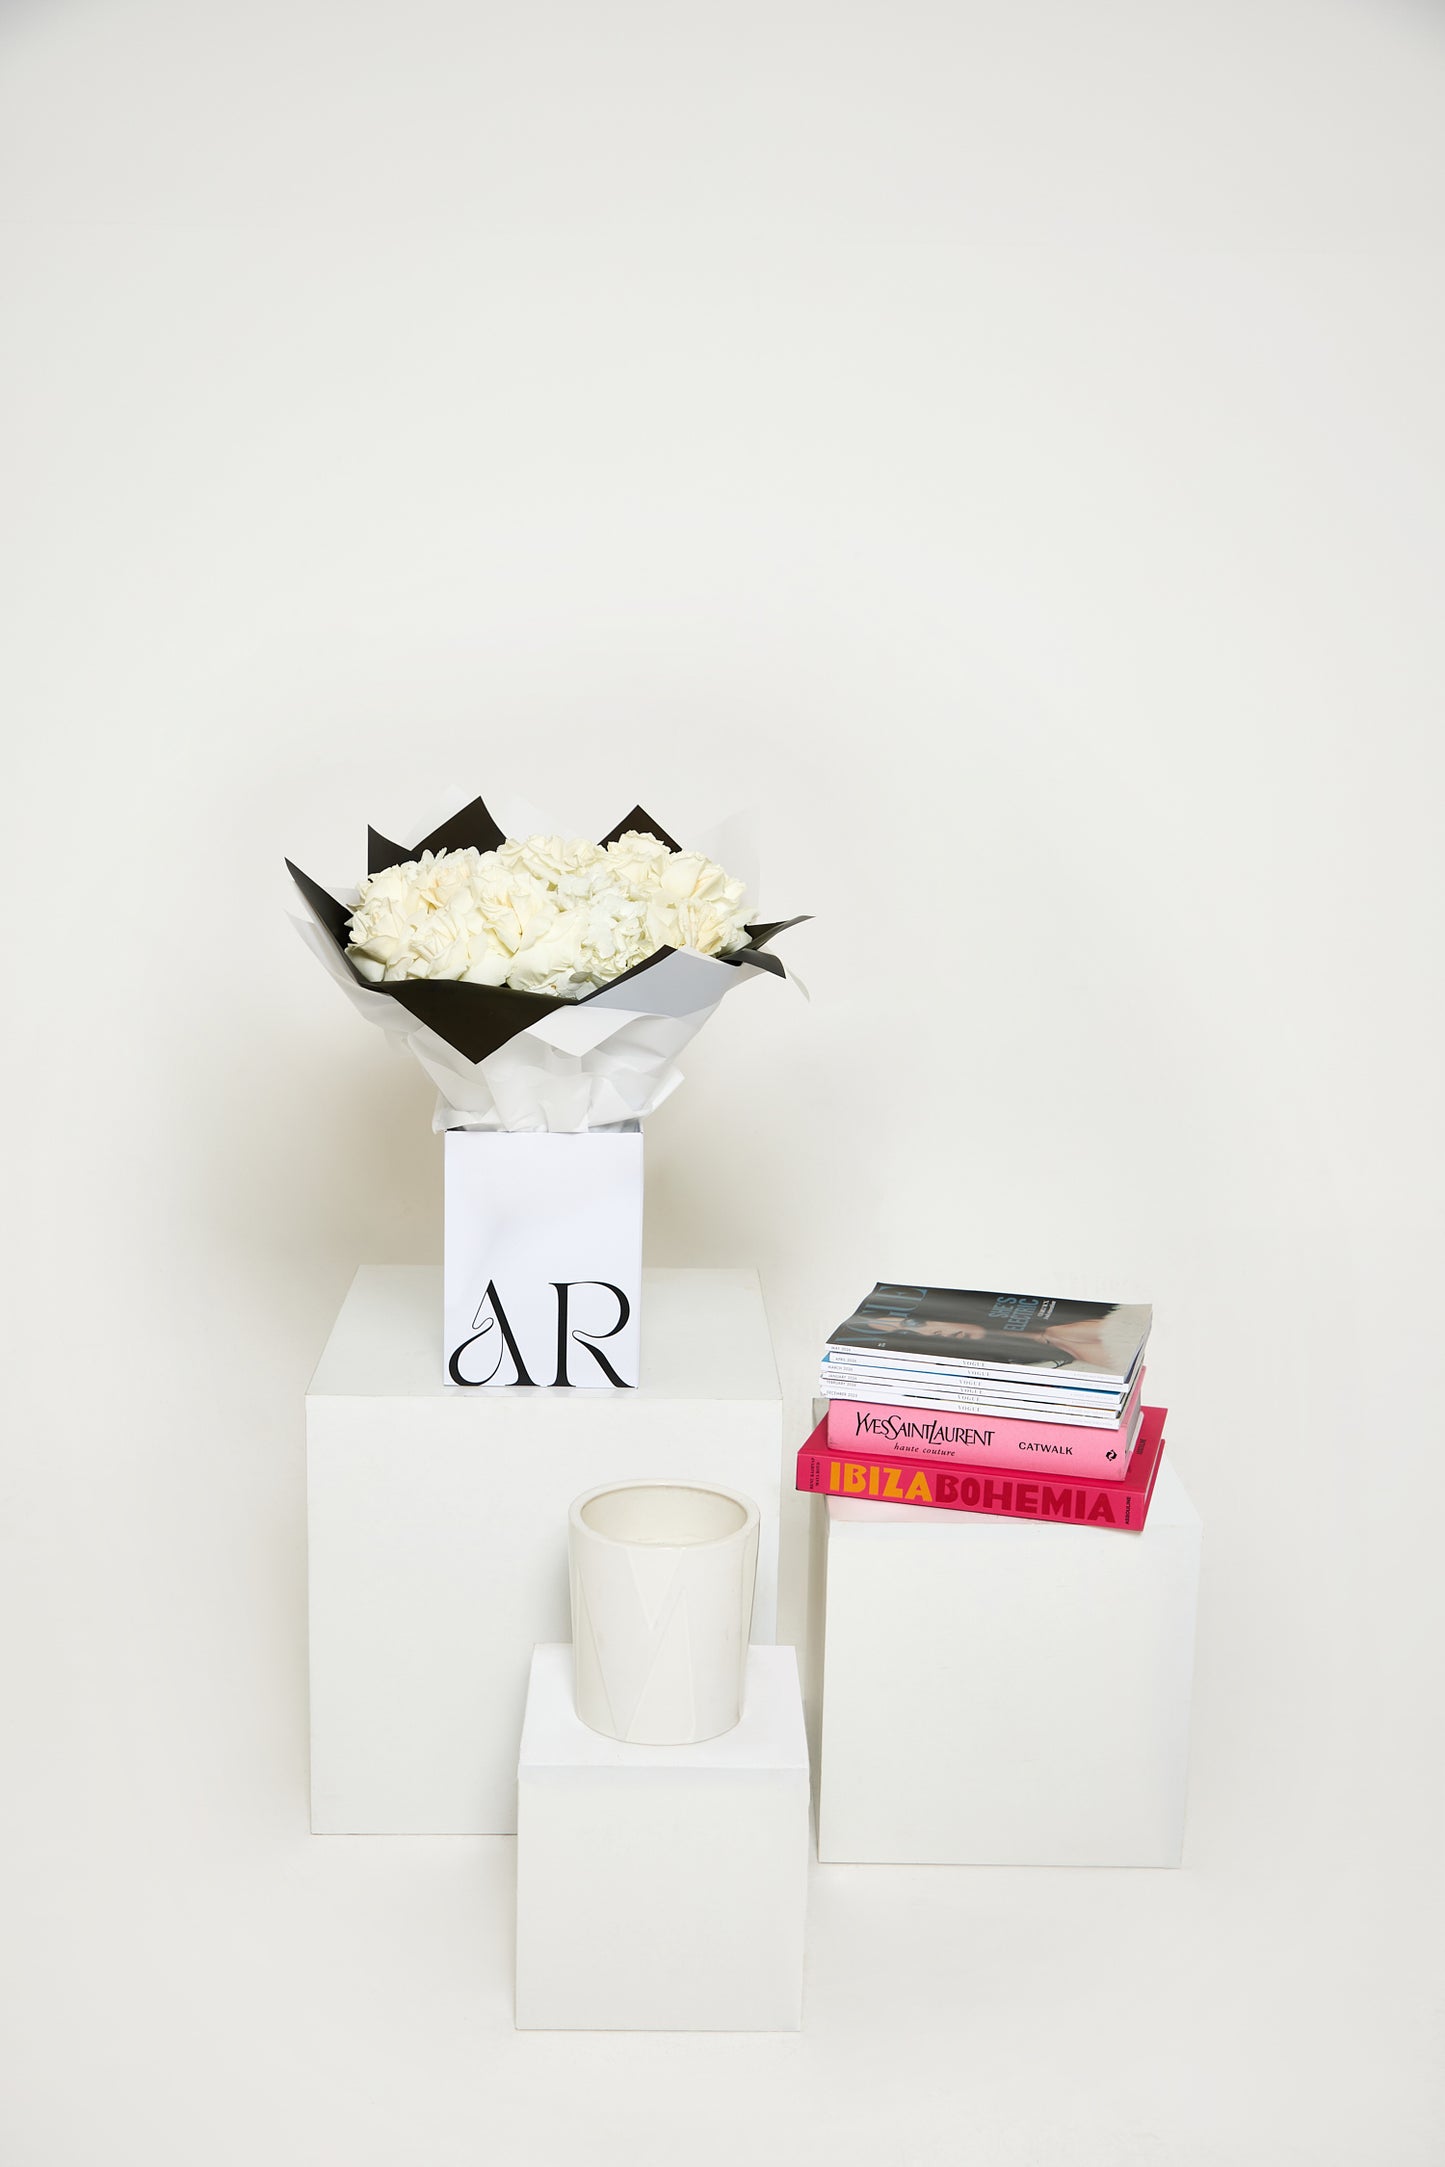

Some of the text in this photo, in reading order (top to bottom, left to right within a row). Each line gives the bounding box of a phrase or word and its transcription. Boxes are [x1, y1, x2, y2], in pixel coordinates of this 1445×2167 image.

[988, 1296, 1017, 1318] SHE'S
[1003, 1298, 1039, 1332] ELECTRIC
[448, 1279, 637, 1388] AR
[893, 1442, 956, 1457] haute couture
[1018, 1441, 1073, 1456] CATWALK
[829, 1461, 1116, 1524] IBIZA BOHEMIA
